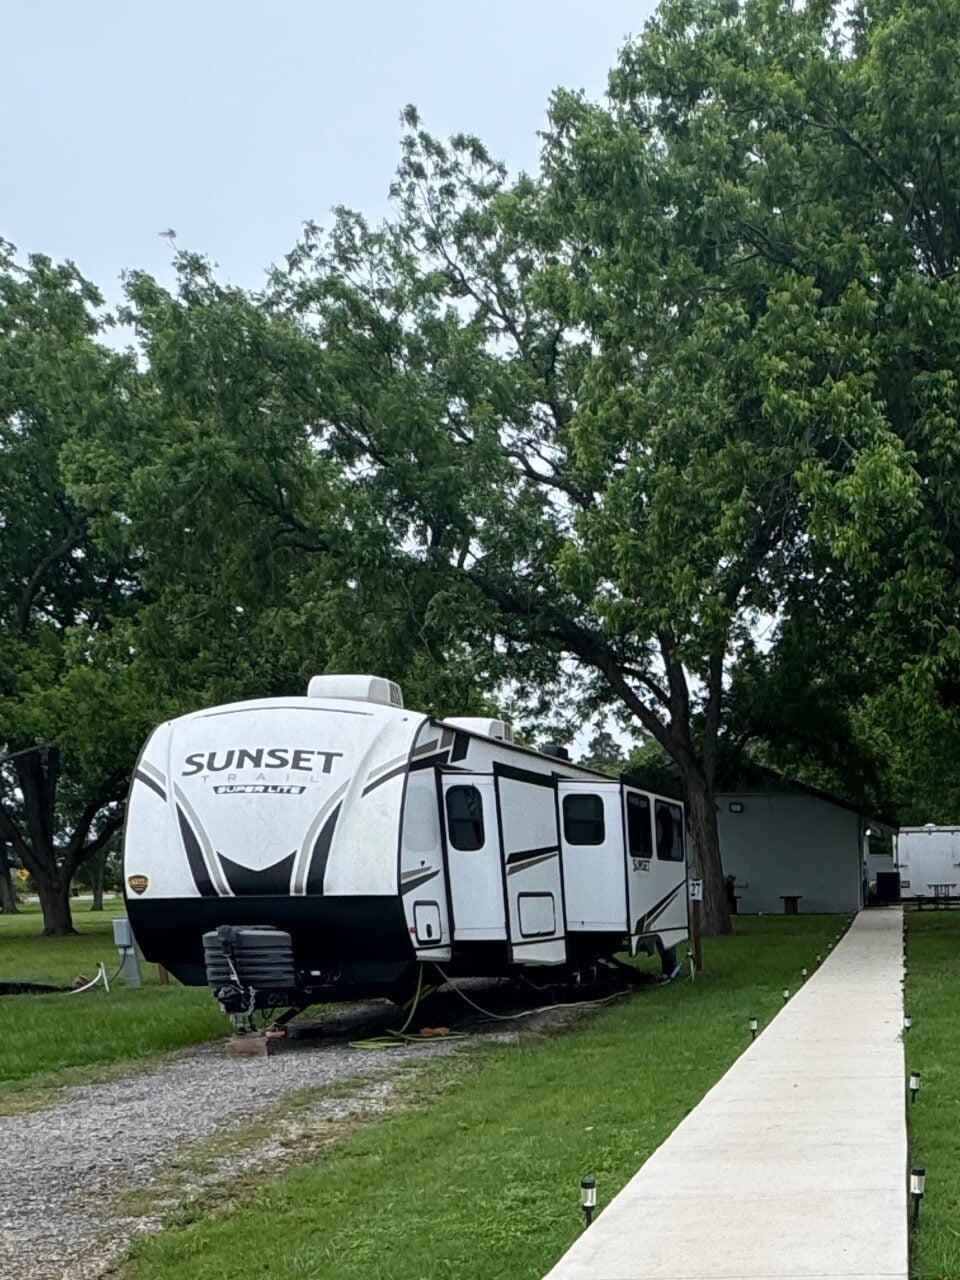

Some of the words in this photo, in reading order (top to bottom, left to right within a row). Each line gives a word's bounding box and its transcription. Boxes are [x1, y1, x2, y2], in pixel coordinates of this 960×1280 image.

[182, 748, 344, 777] SUNSET
[201, 772, 320, 784] TRAIL
[217, 785, 265, 794] SUPER
[268, 785, 302, 794] LITE
[690, 882, 702, 897] 27
